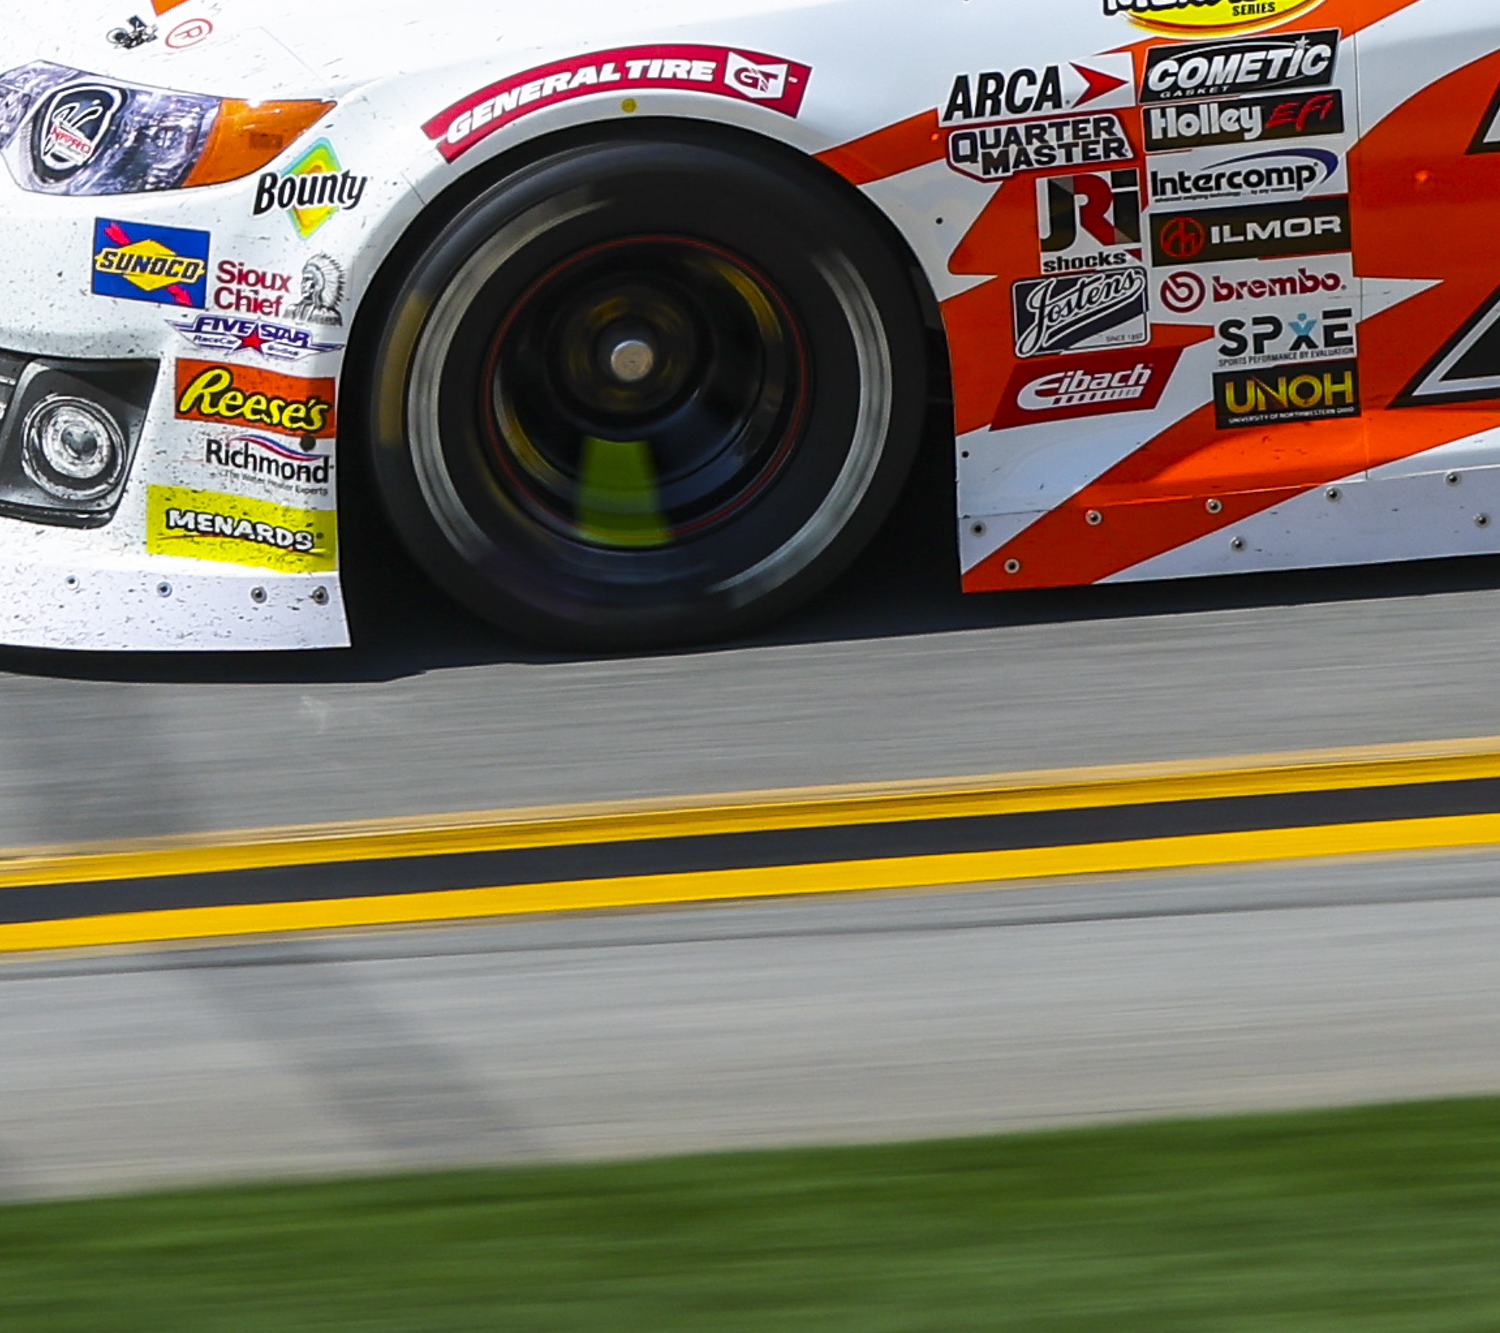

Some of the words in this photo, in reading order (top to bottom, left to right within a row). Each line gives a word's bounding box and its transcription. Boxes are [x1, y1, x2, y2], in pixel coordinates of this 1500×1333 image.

[1232, 1, 1276, 17] SERIES
[1147, 37, 1333, 92] COMETIC
[445, 59, 620, 144] GENERAL
[618, 58, 718, 84] TIRE
[943, 65, 1063, 123] ARCA
[1160, 85, 1231, 99] GASKET
[951, 116, 1118, 164] QUARTER
[1149, 102, 1264, 141] Holley
[981, 141, 1127, 176] MASTER
[253, 170, 368, 216] Bounty
[1151, 164, 1318, 197] Intercomp
[1211, 215, 1342, 244] ILMOR
[98, 250, 203, 281] SUNOCO
[215, 260, 293, 293] Sioux
[1042, 250, 1128, 274] shocks
[213, 286, 284, 317] Chief
[1213, 272, 1342, 302] brembo
[193, 316, 251, 334] FIVE
[259, 322, 312, 346] STAR
[1016, 269, 1138, 357] Jostens
[179, 368, 329, 432] Reese's
[1016, 363, 1151, 411] Eibach
[1225, 371, 1354, 414] UNOH
[205, 437, 331, 485] Richmond
[166, 507, 316, 551] MENARDS
